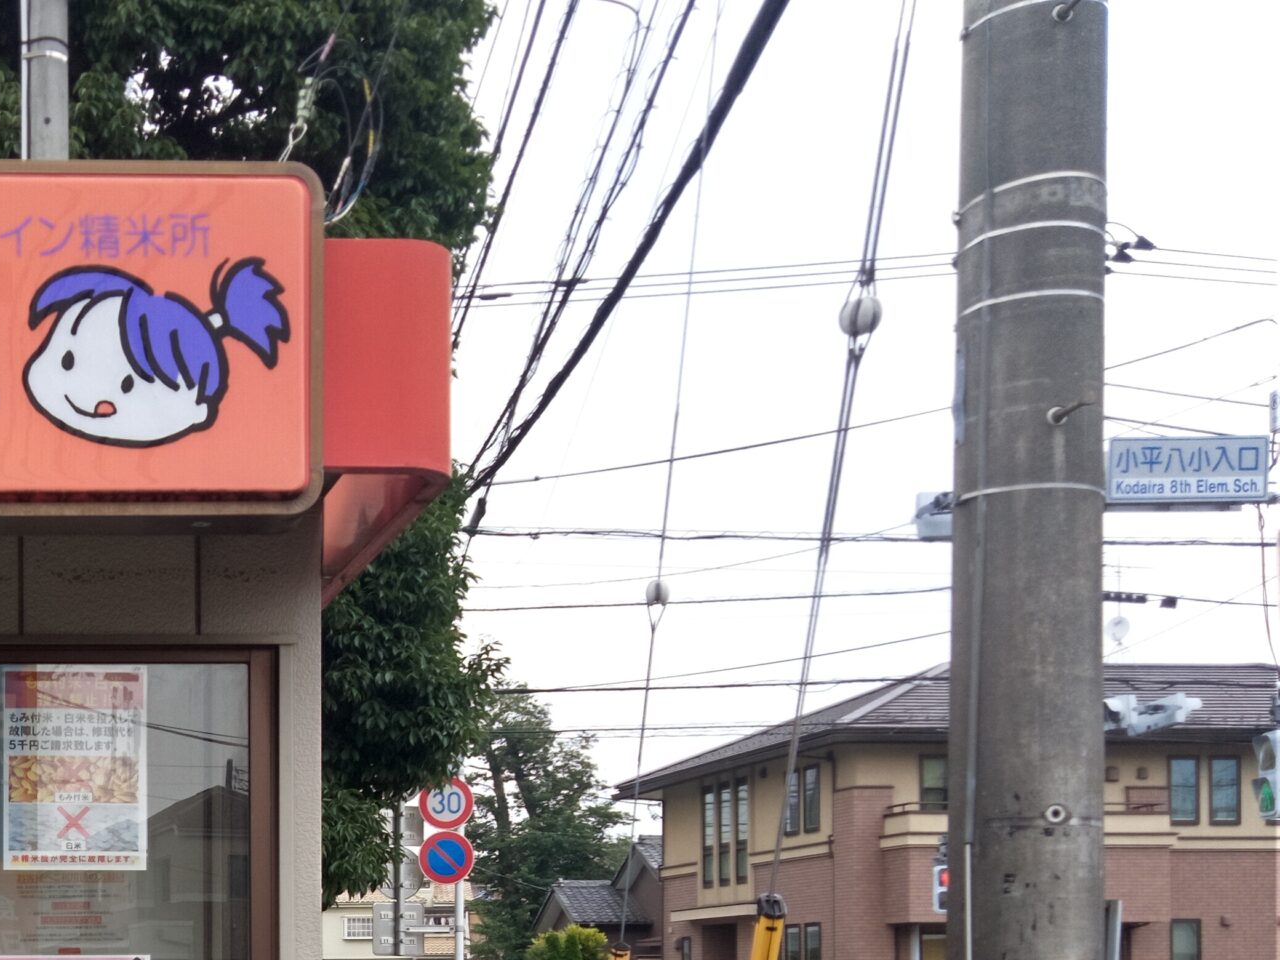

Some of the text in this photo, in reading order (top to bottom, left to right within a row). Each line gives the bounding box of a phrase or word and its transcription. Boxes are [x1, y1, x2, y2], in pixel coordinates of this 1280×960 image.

[1115, 446, 1260, 473] 小平八小入口
[1116, 478, 1260, 494] Kodaira 8th Elem. Sch.
[431, 791, 461, 814] 30
